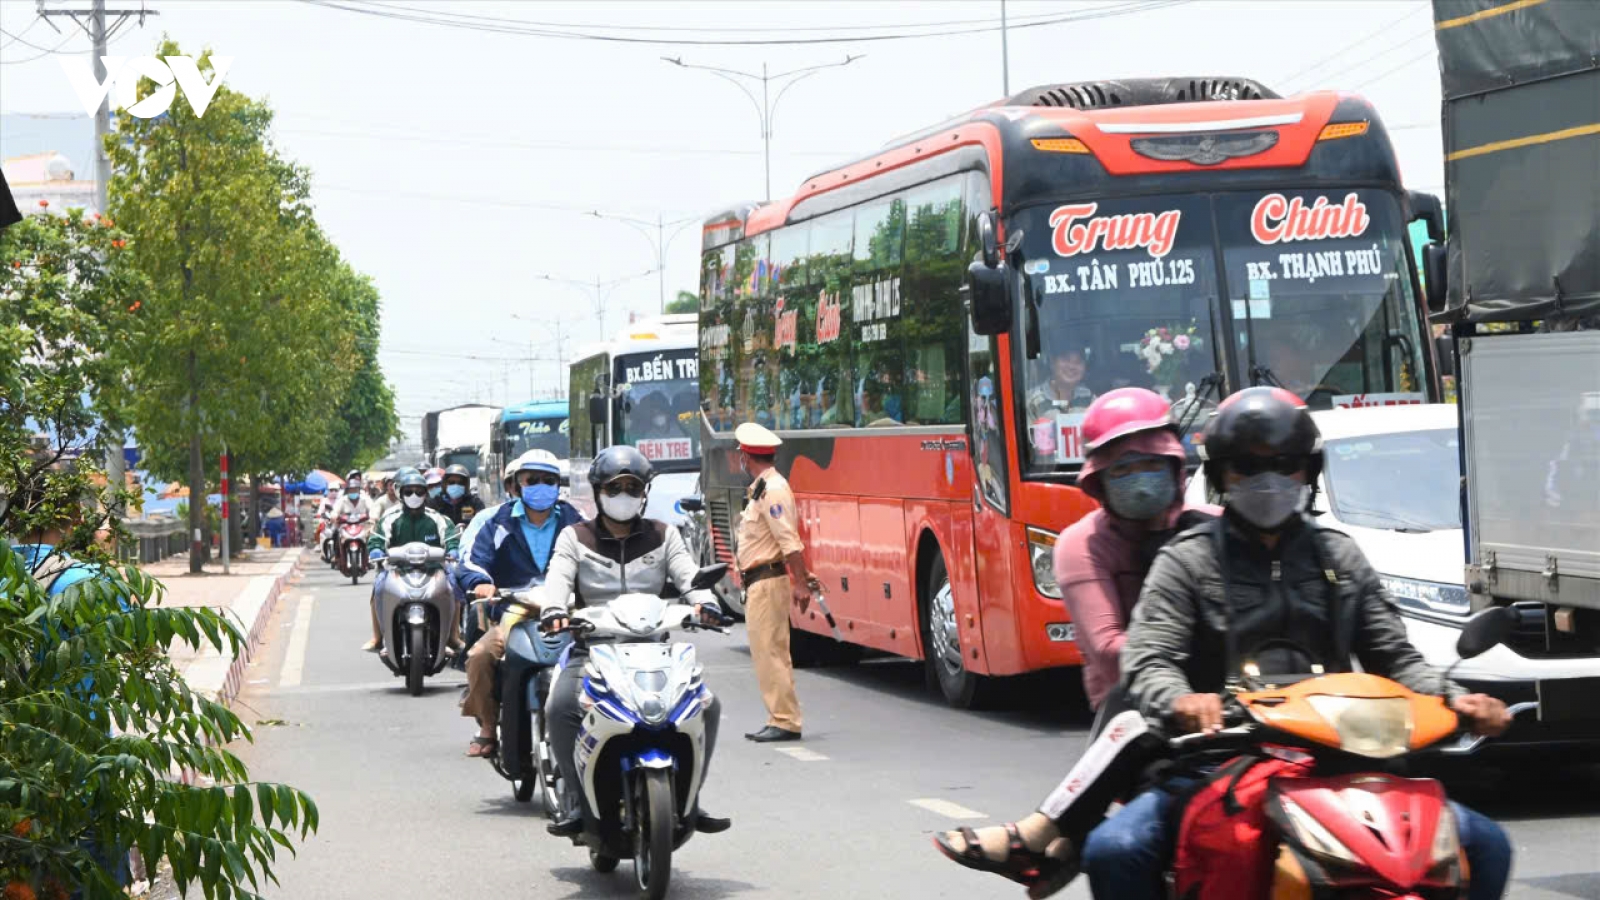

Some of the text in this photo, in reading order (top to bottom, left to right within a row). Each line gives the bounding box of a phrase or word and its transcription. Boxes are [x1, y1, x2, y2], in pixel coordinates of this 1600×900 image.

[1049, 193, 1370, 257] Trung Chính
[1044, 274, 1076, 294] BX.
[1077, 258, 1118, 291] TÂN
[1246, 243, 1381, 283] BX. THẠNH PHÚ
[676, 352, 699, 379] TR
[666, 442, 690, 458] TRE
